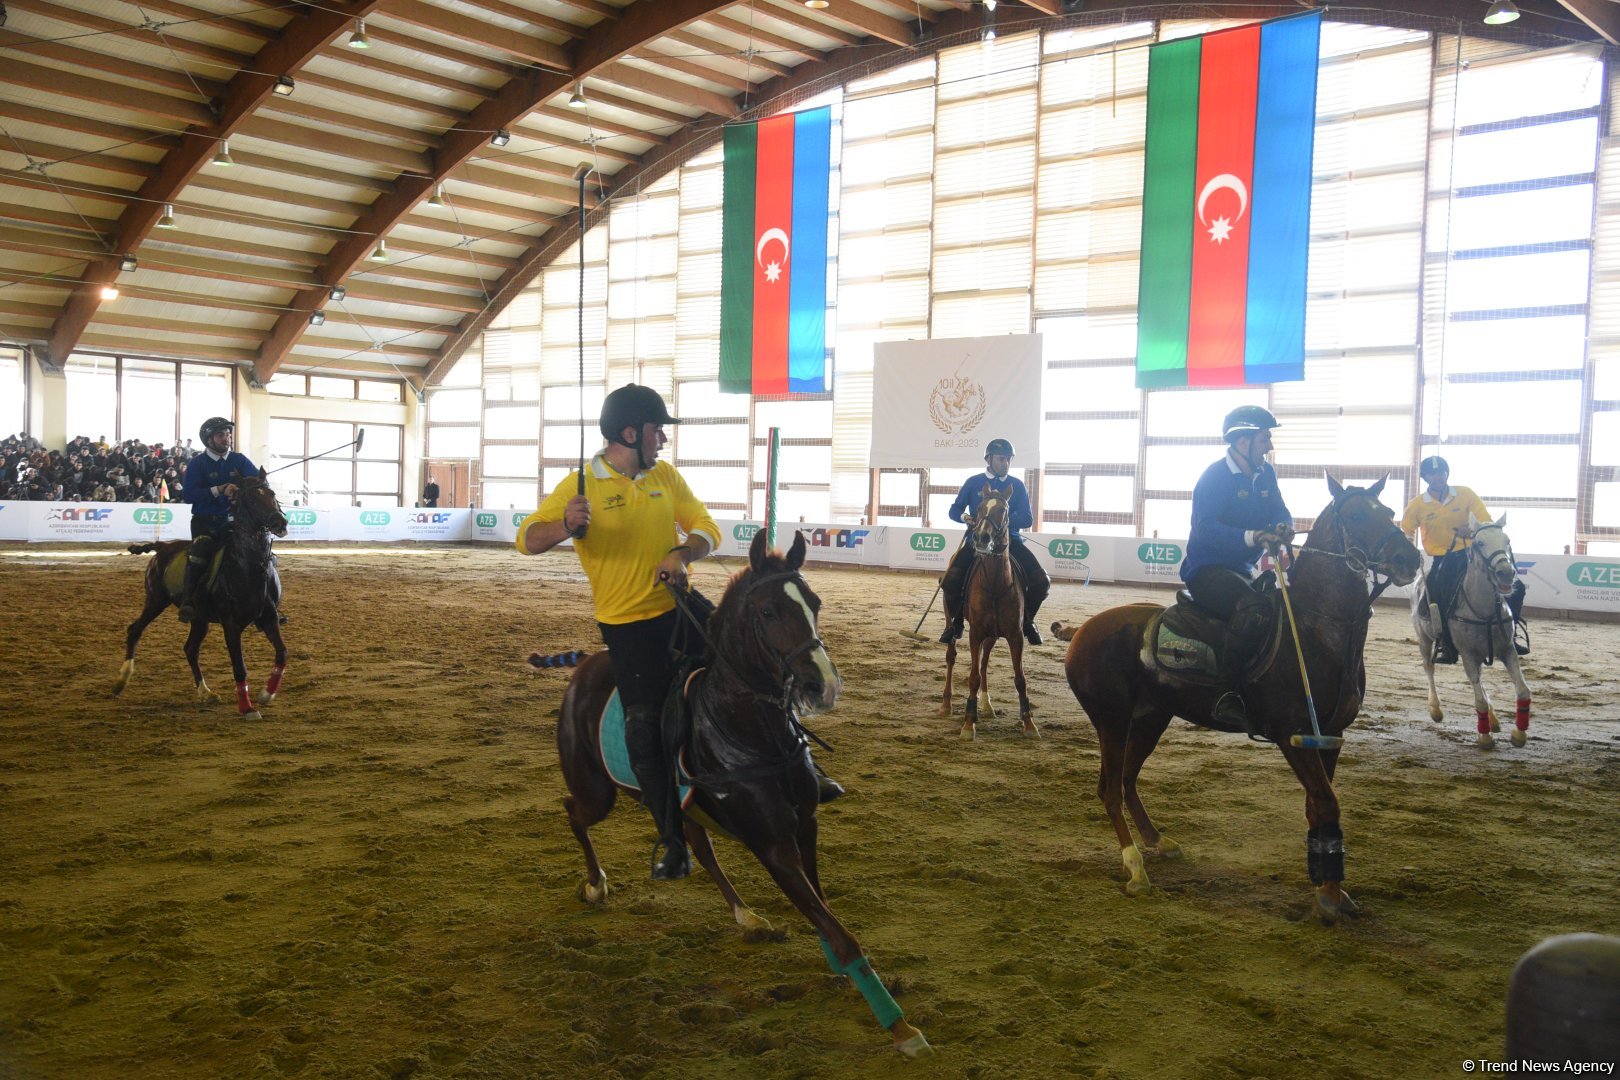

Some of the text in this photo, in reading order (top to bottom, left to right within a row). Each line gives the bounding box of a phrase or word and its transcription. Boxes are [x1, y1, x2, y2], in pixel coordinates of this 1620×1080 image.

[139, 510, 167, 522] AZE
[289, 512, 311, 524] AZE
[364, 513, 386, 524] AZE
[479, 515, 494, 526] AZE
[915, 535, 940, 549] AZE
[1055, 542, 1083, 556] AZE
[1144, 546, 1175, 561] AZE
[1577, 566, 1620, 584] AZE
